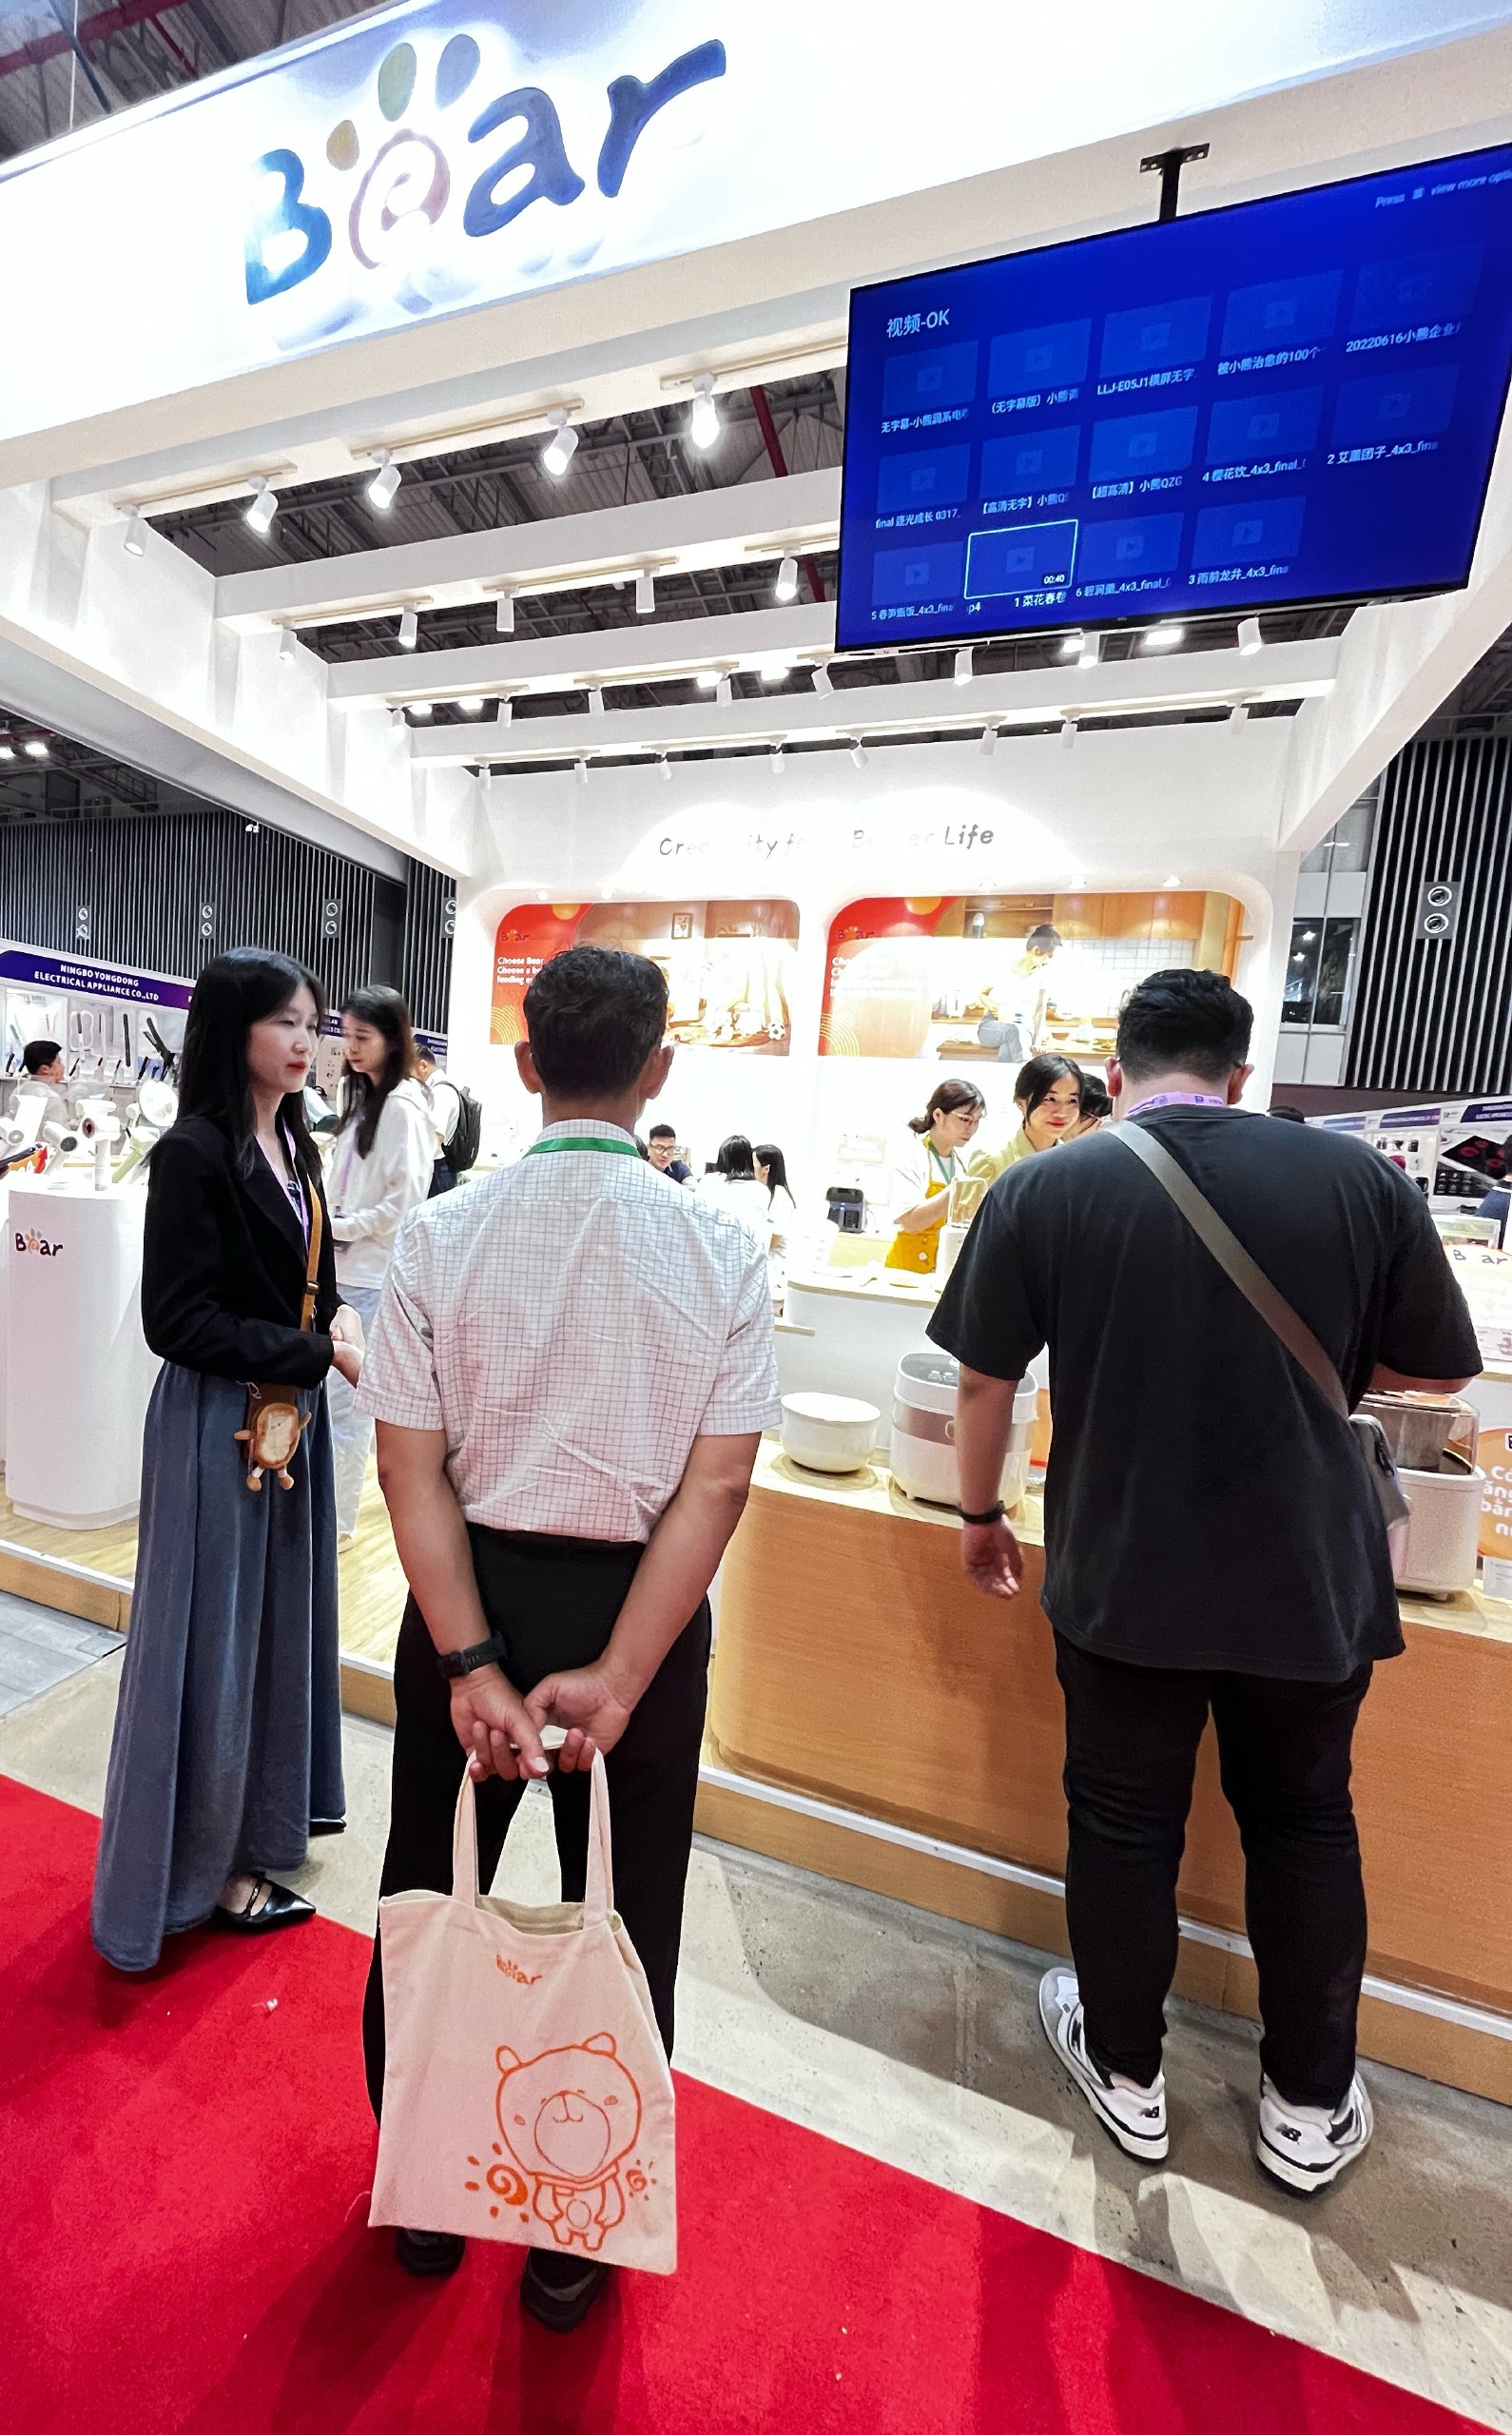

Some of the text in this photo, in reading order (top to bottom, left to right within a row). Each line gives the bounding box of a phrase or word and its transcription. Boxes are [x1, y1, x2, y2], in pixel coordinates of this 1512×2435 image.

[245, 34, 726, 304] Bear
[1375, 194, 1405, 207] Press
[1431, 183, 1456, 195] view
[1458, 176, 1486, 189] more
[886, 309, 949, 339] 视频-OK
[1327, 454, 1335, 464] 2
[1202, 472, 1210, 481] 4
[876, 517, 894, 529] final
[1043, 574, 1065, 584] 00:40
[1188, 575, 1195, 584] 3
[1076, 588, 1082, 597] 6
[1014, 597, 1019, 607] 1
[871, 611, 878, 620] 5
[943, 822, 995, 850] Life
[497, 956, 525, 965] Choose
[60, 964, 140, 987] NINGBO YONGDONG
[496, 965, 525, 975] Choose
[34, 970, 86, 988] ELECTRICAL
[87, 981, 130, 997] APPLIANCE
[15, 1229, 63, 1256] Bear
[1453, 1249, 1508, 1264] Bar
